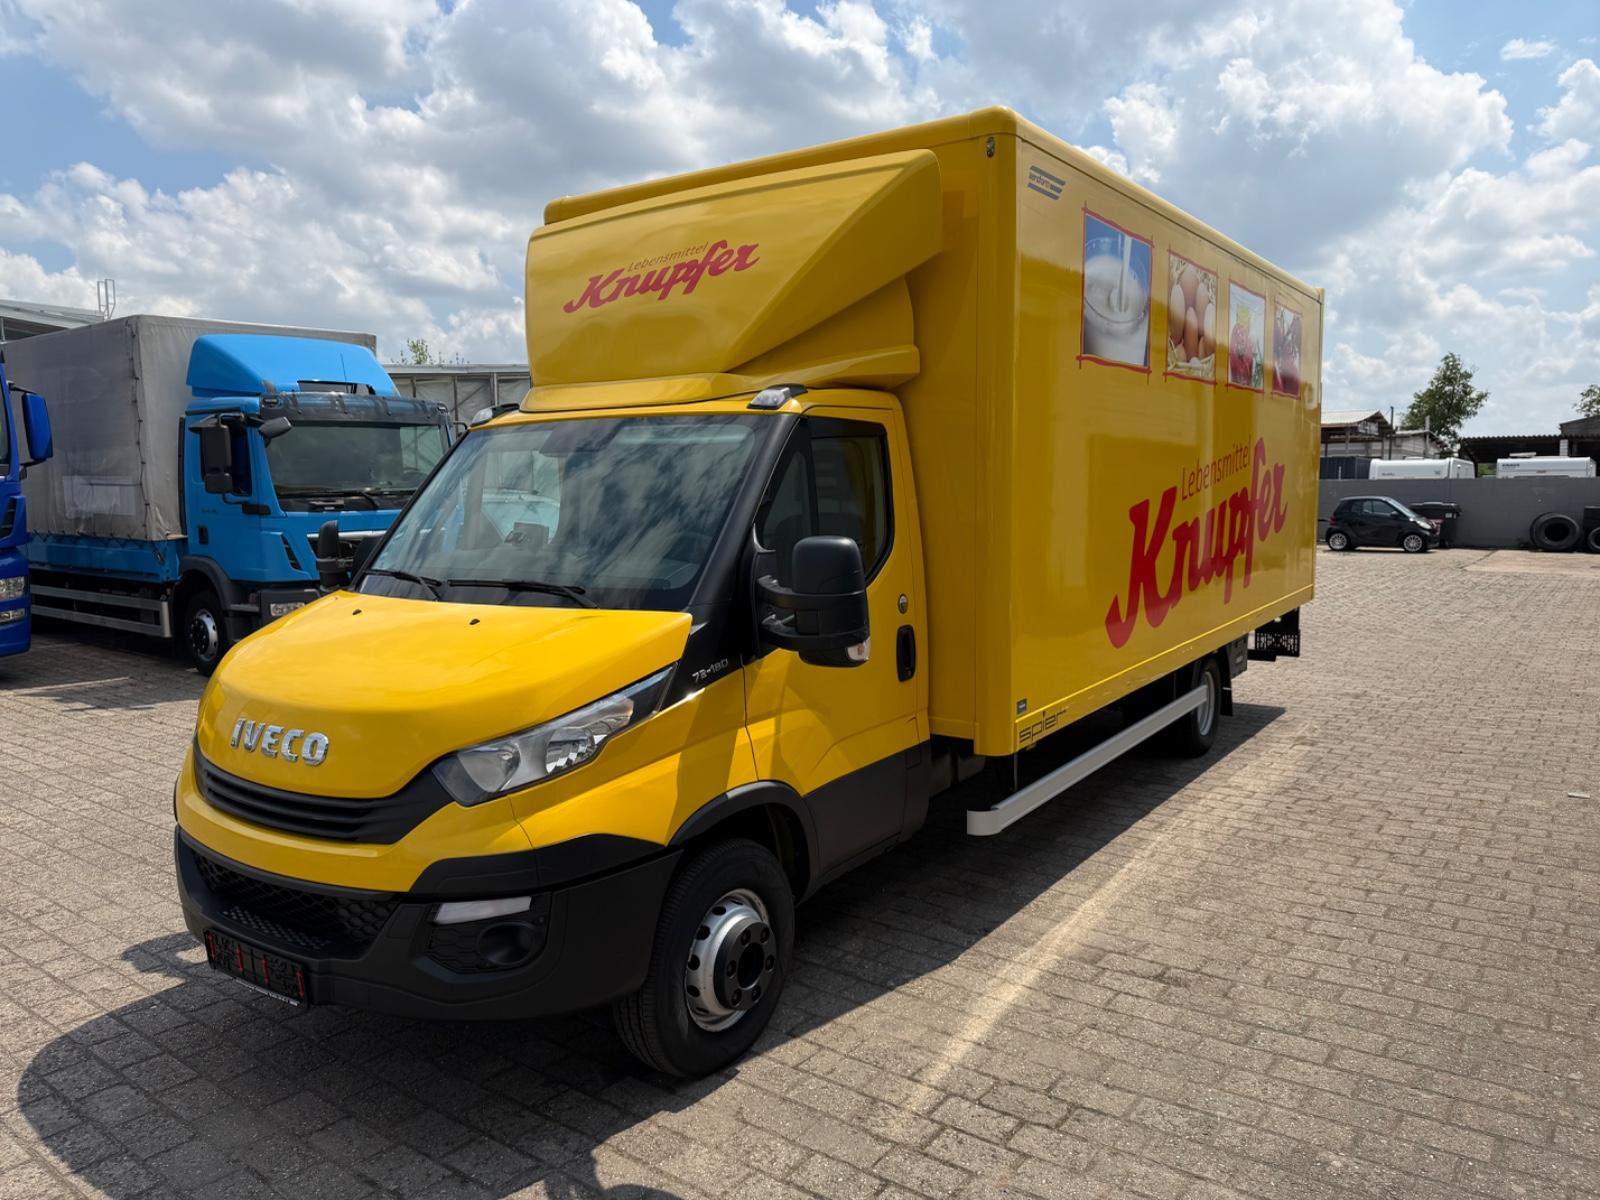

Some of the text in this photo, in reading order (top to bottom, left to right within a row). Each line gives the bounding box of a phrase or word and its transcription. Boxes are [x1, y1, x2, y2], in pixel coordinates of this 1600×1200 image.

[563, 240, 760, 313] Knupfer
[627, 242, 709, 273] Lebensmittel
[1181, 435, 1252, 501] Lebensmittel
[1105, 437, 1288, 649] Knupfer
[230, 718, 329, 766] IVECO
[1018, 710, 1067, 744] spier
